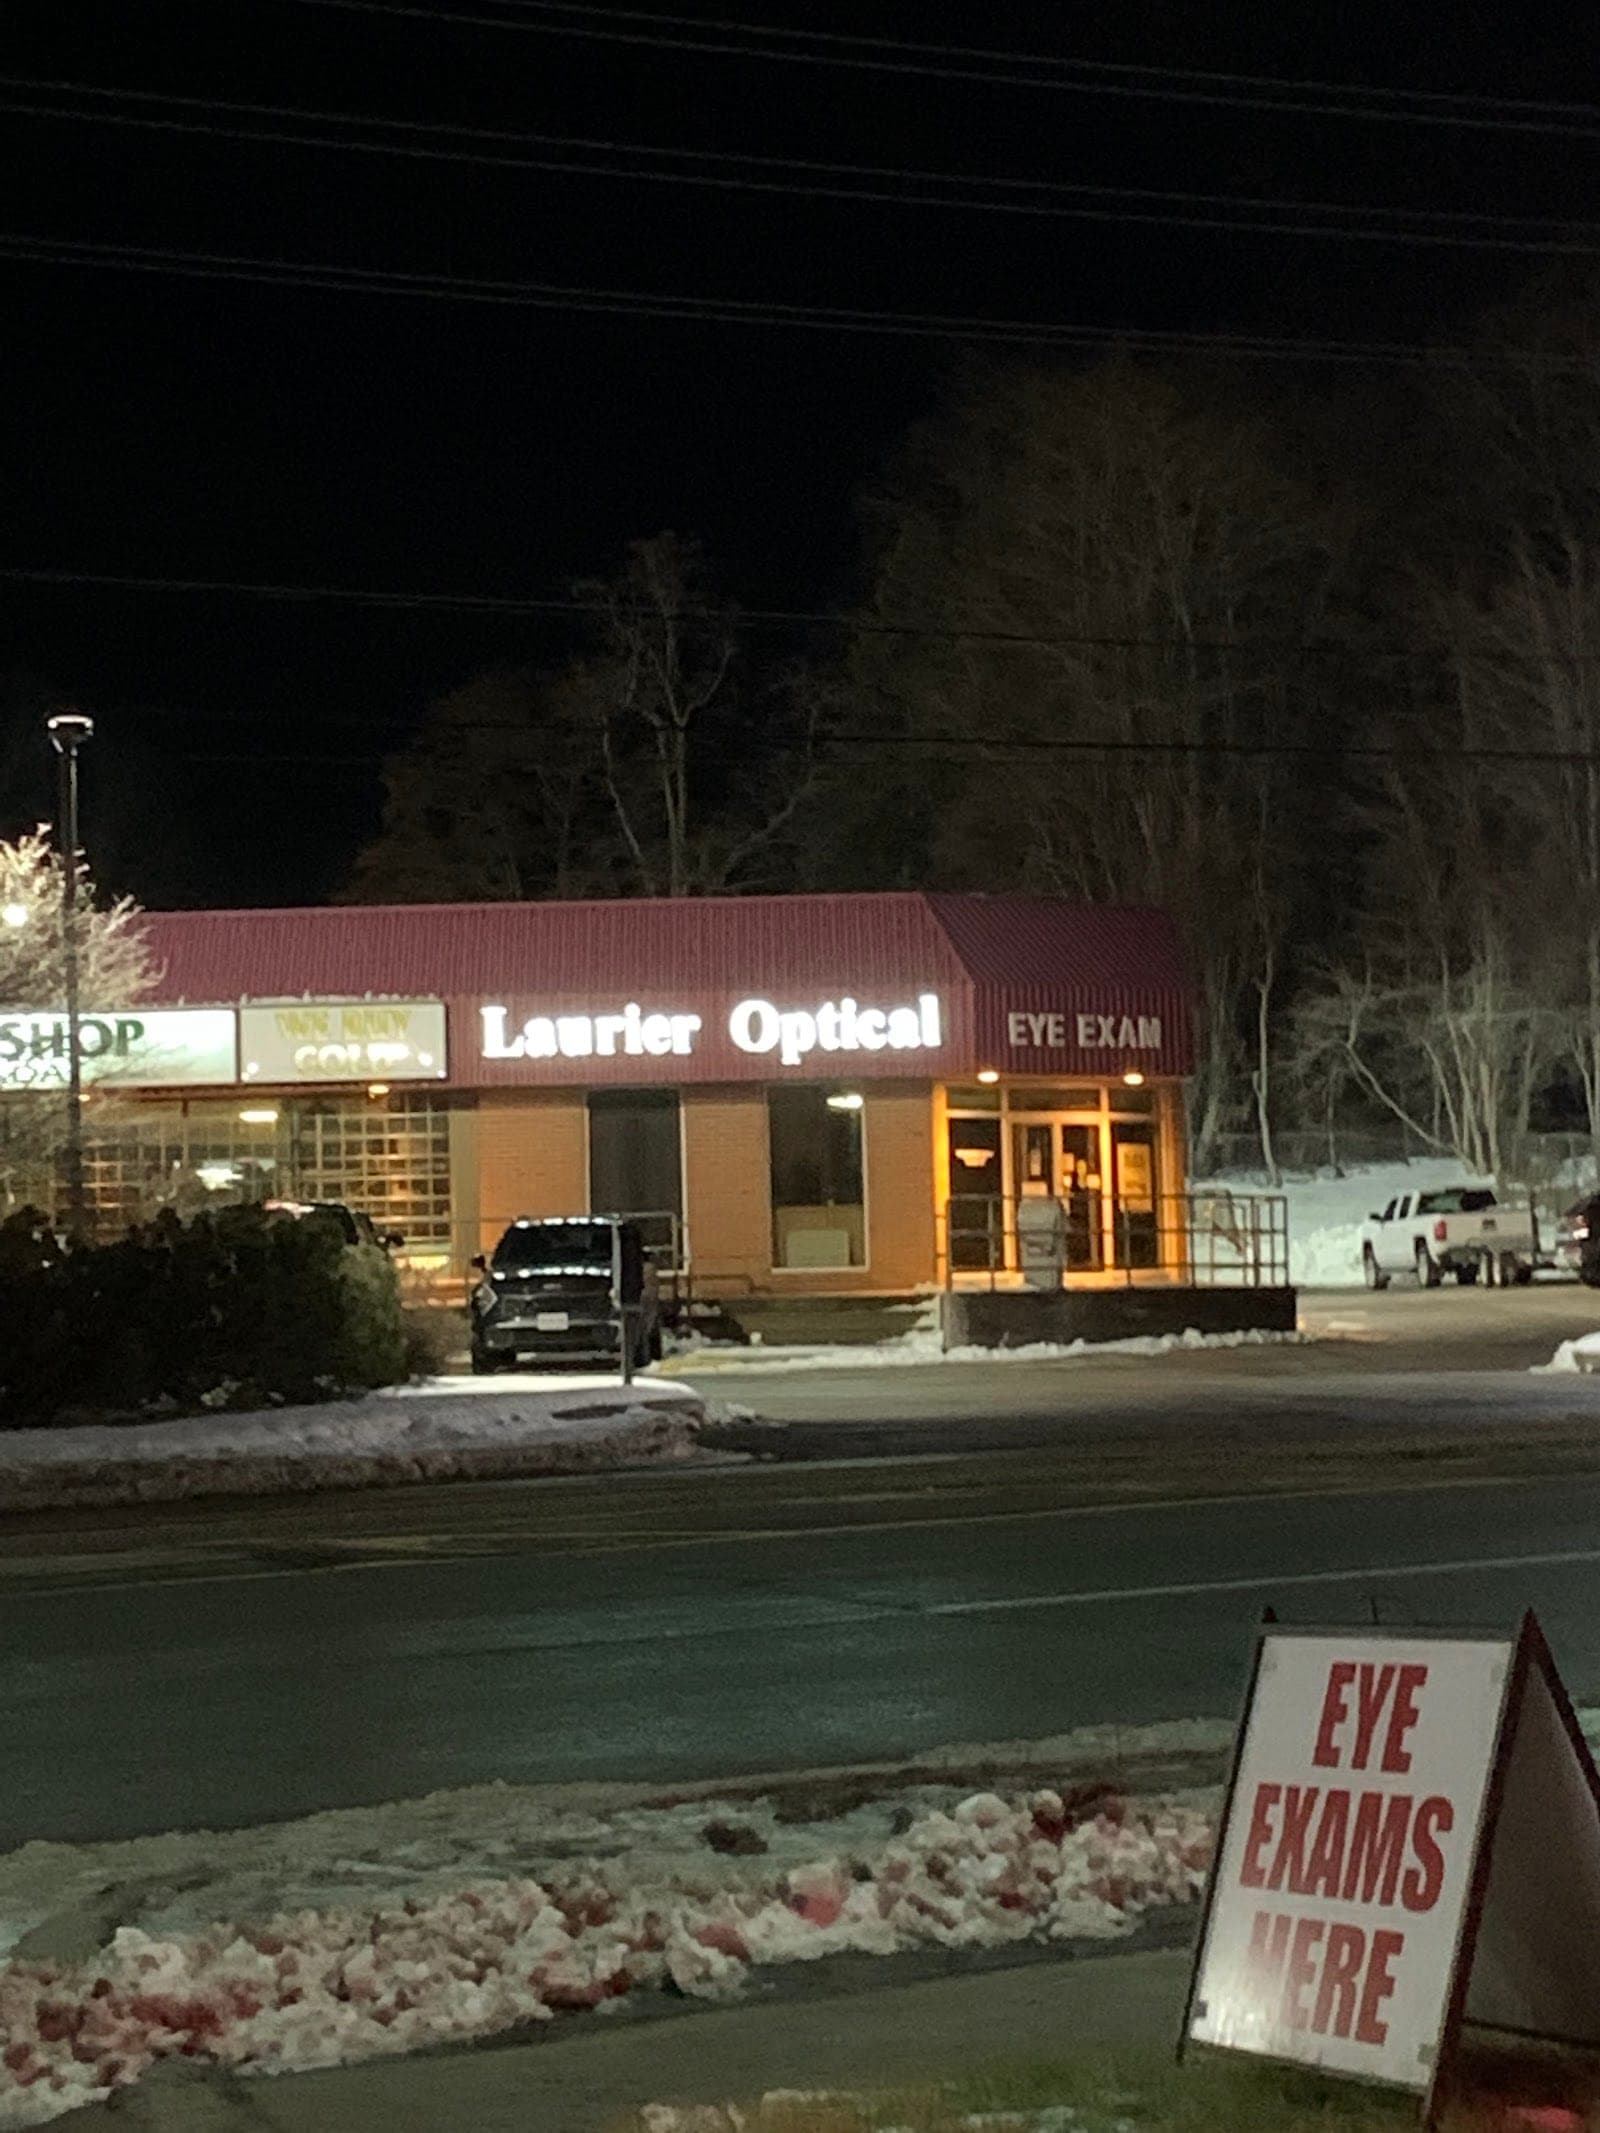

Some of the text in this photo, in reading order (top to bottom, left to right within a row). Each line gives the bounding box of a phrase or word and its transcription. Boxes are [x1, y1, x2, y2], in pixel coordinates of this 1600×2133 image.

[0, 1018, 145, 1062] SHOP
[479, 994, 942, 1065] Laurier Optical
[1008, 1012, 1162, 1049] EYE EXAM
[1312, 1663, 1428, 1774] EYE
[1239, 1783, 1454, 1913] EXAMS
[1242, 1911, 1405, 2046] HERE
